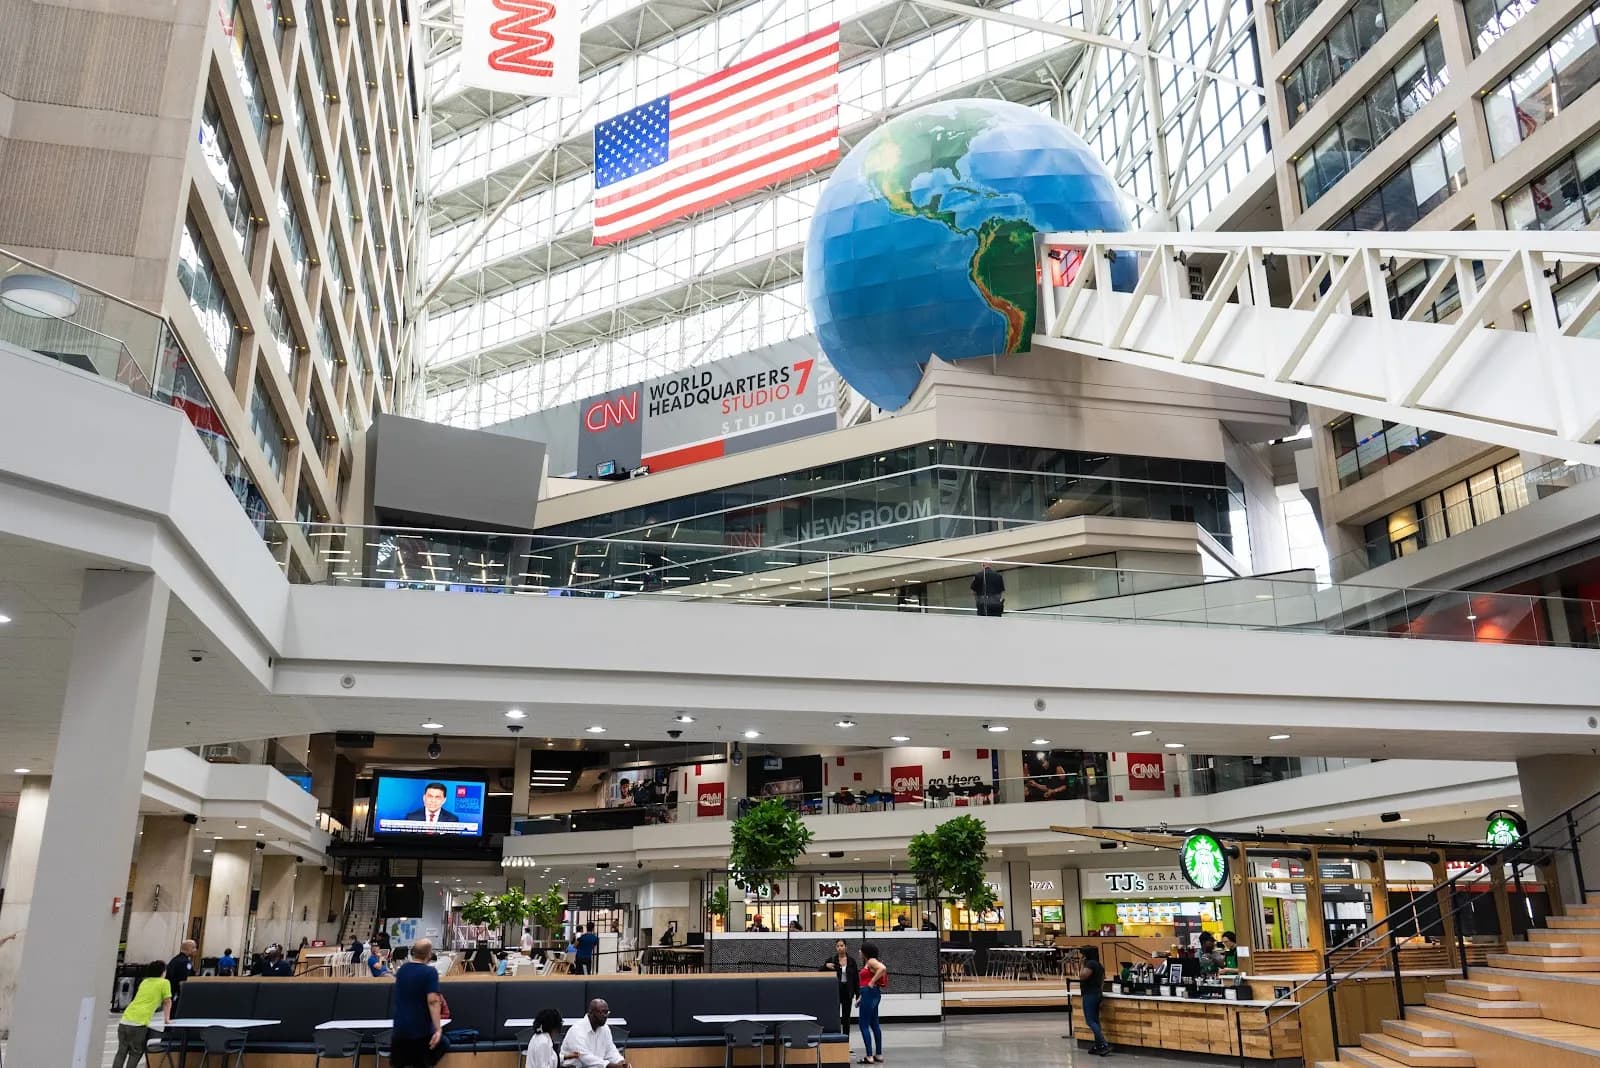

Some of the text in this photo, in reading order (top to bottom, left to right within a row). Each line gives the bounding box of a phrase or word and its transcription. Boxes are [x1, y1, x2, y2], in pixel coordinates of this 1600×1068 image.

[488, 0, 556, 77] NN
[649, 366, 790, 418] HEADQUARTERS
[650, 371, 713, 401] WORLD
[721, 358, 814, 415] STUDIO 7
[585, 390, 641, 433] CNN
[721, 403, 805, 435] STUDIO
[797, 497, 932, 540] NEWSROOM
[894, 776, 920, 791] CNN
[1131, 763, 1160, 779] CNN
[700, 792, 721, 807] CNN
[844, 884, 891, 894] souhwest
